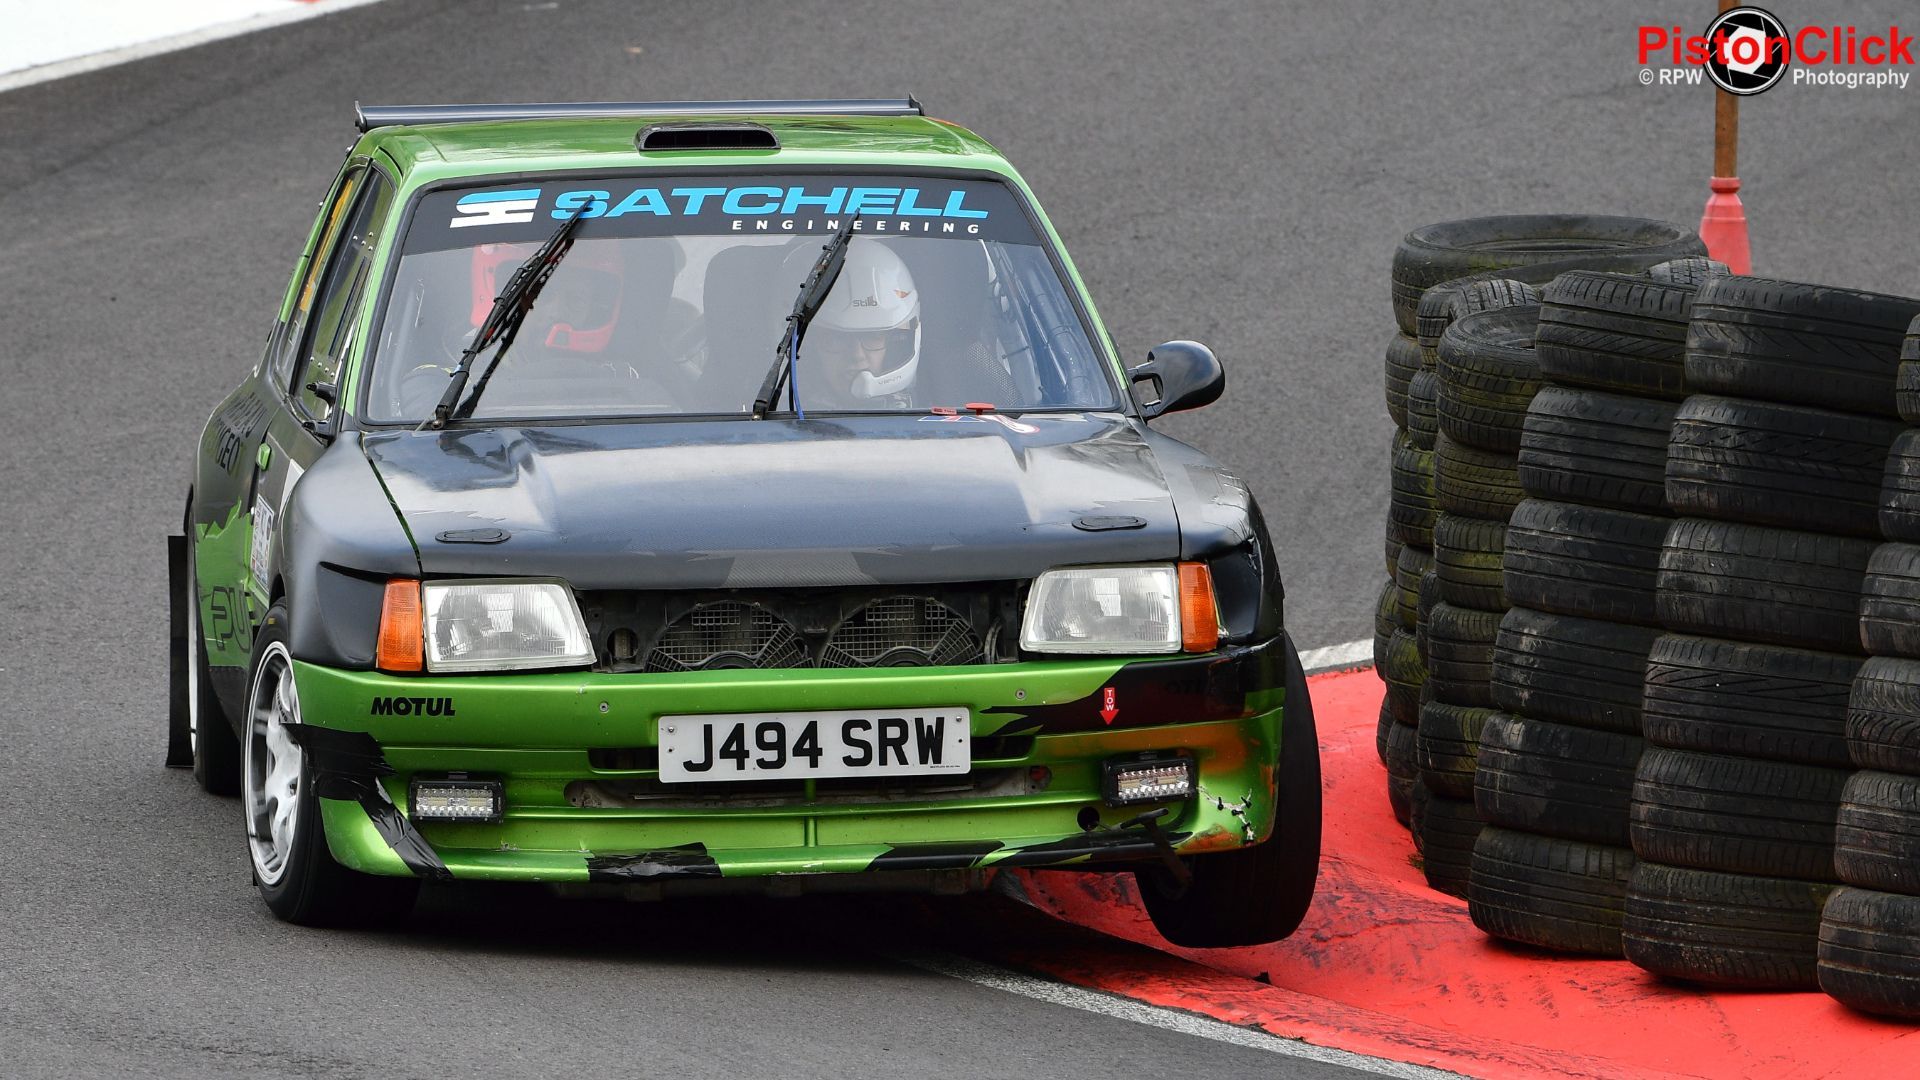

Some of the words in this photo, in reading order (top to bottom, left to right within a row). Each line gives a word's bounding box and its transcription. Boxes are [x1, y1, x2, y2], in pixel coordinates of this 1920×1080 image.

[551, 187, 989, 219] SATCHELL
[732, 219, 979, 234] ENGINEERING
[370, 696, 456, 716] MOTUL
[1105, 689, 1115, 712] TOW
[682, 720, 823, 773] J494
[841, 717, 945, 767] SRW
